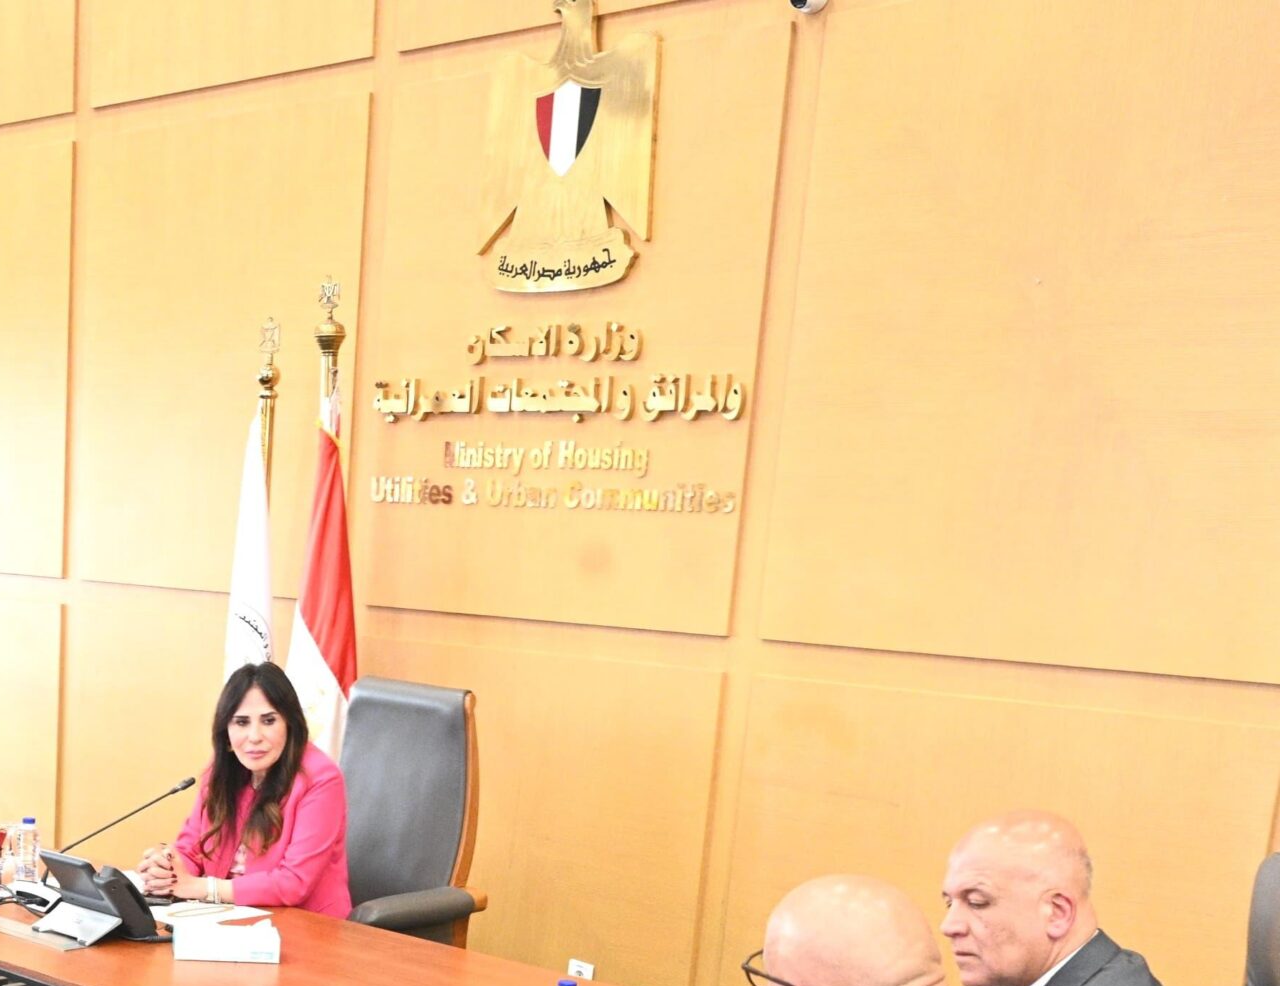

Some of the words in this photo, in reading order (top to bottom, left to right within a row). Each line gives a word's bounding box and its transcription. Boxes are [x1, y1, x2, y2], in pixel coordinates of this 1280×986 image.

[498, 255, 538, 280] العربية
[535, 267, 563, 282] مصر
[564, 248, 617, 279] جمهورية
[566, 321, 643, 363] وزارة
[371, 376, 485, 424] العمرانية
[443, 440, 524, 476] Ministry
[529, 439, 553, 470] of
[557, 439, 650, 479] Housing
[370, 475, 454, 505] Utilities
[462, 477, 479, 505] &
[484, 479, 558, 509] Urban
[562, 480, 736, 514] Communities
